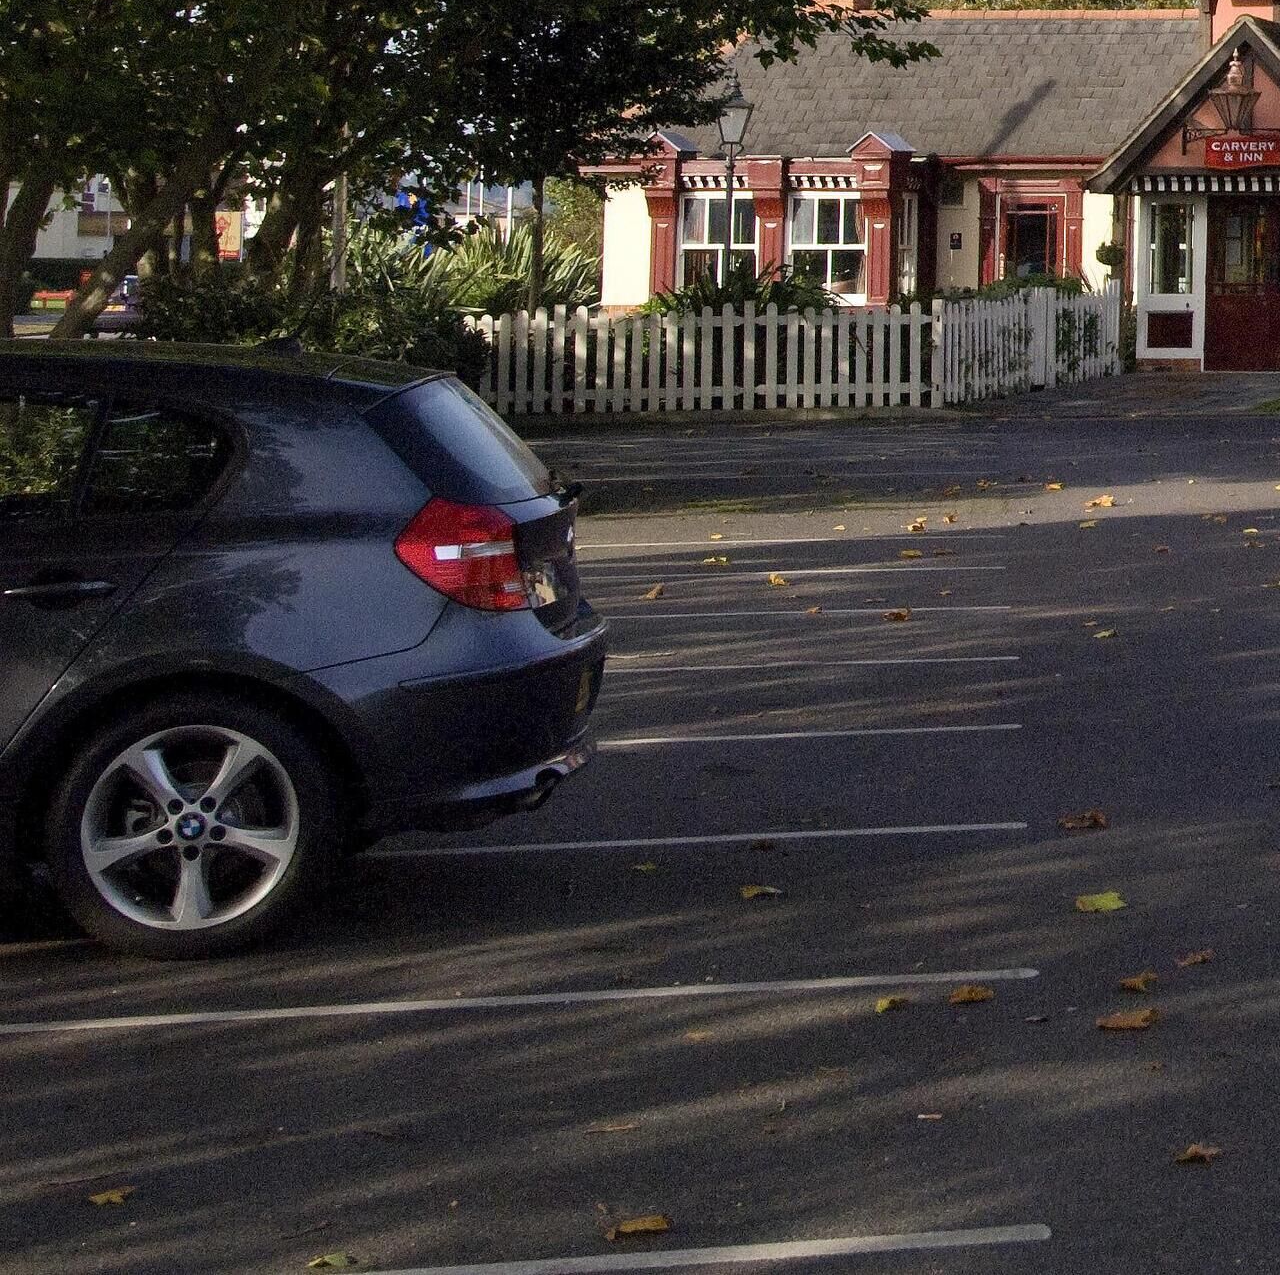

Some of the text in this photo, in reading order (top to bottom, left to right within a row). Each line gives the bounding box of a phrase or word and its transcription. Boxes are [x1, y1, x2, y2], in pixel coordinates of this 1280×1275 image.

[1211, 141, 1275, 151] CARVERY
[1223, 152, 1263, 162] & INN
